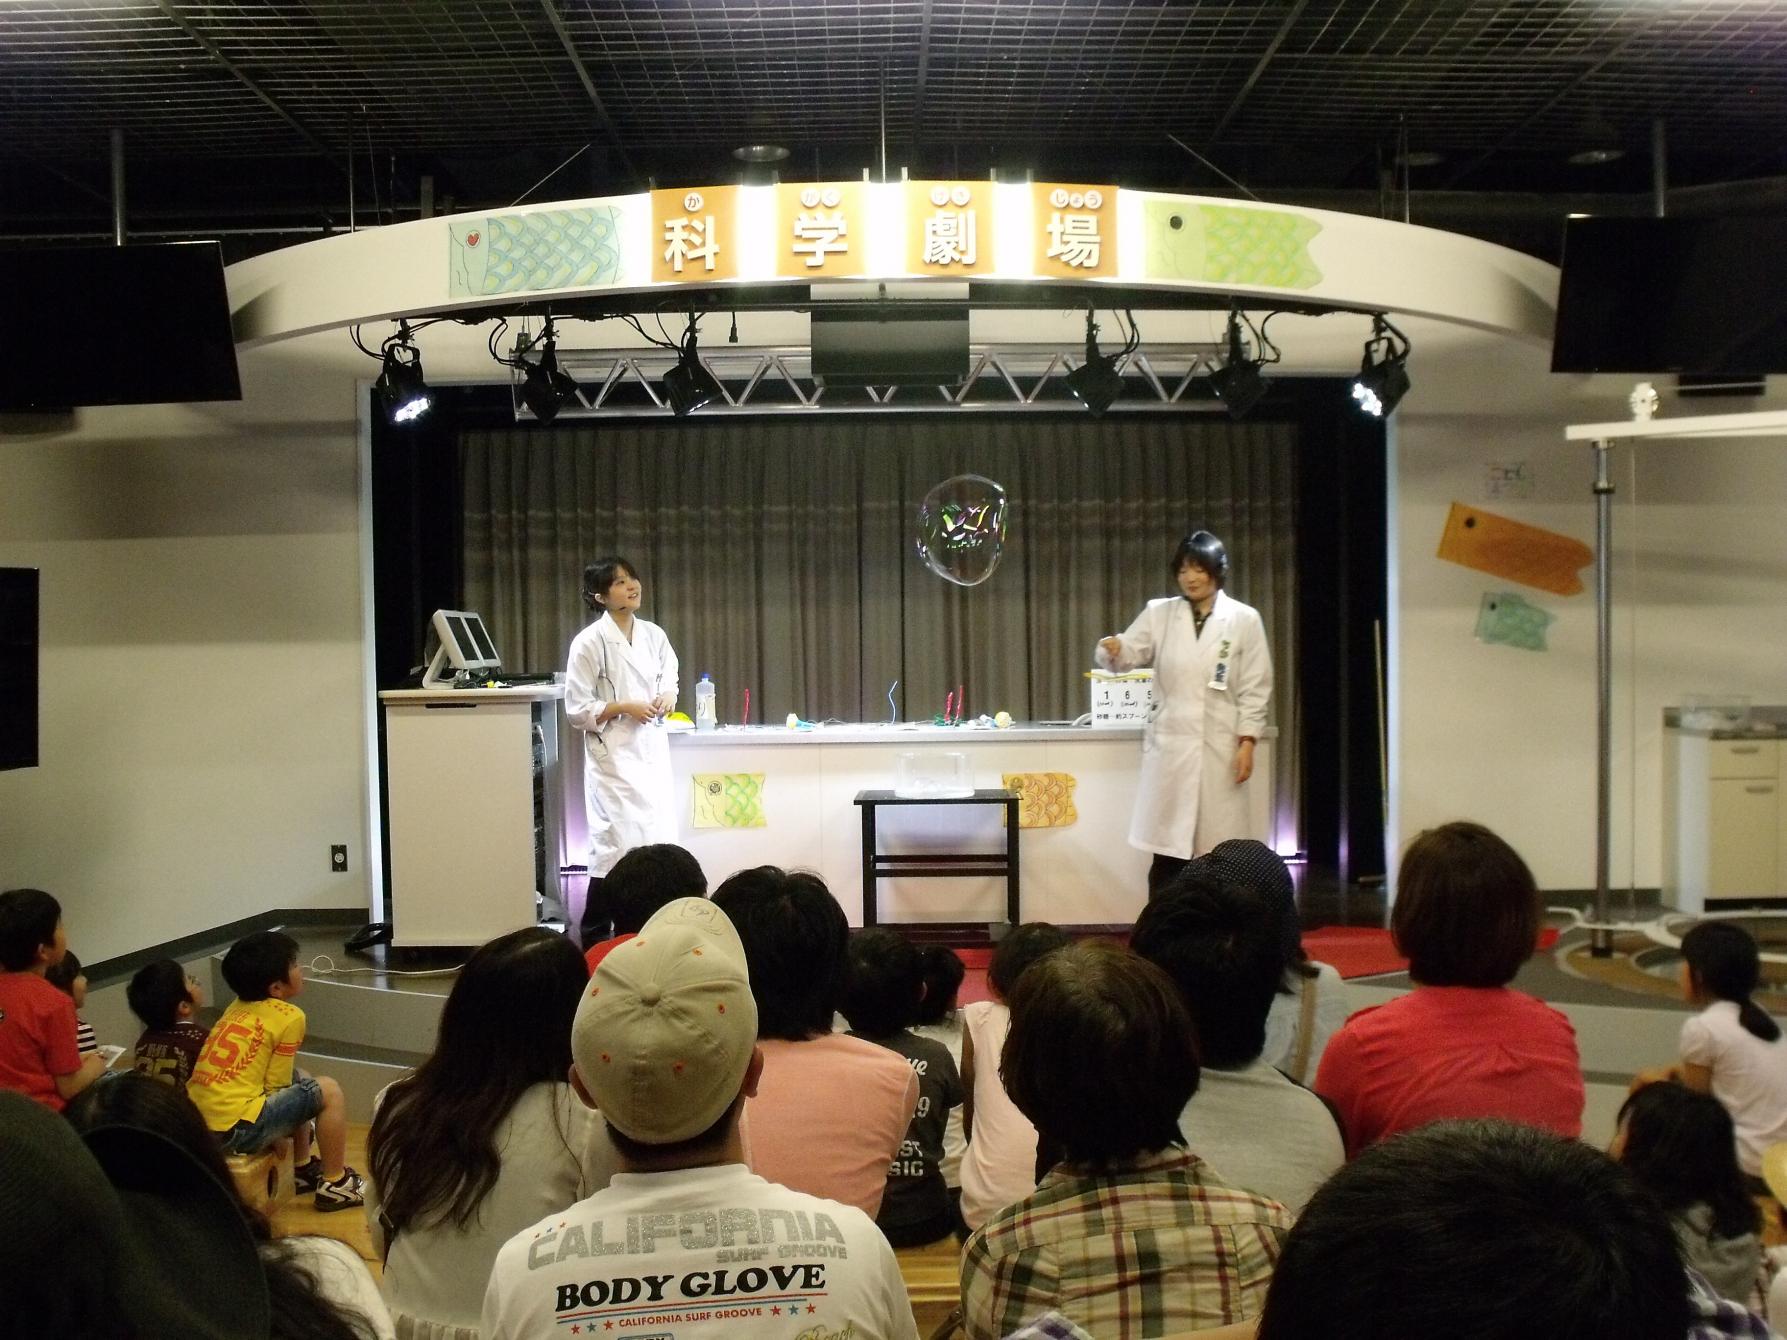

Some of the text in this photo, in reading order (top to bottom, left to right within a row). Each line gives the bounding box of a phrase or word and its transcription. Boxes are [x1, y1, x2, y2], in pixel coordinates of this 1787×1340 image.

[685, 195, 702, 210] か
[1055, 189, 1100, 207] じょう
[664, 210, 1101, 272] 科学劇場
[1104, 690, 1109, 700] 1
[1125, 690, 1130, 700] 6
[528, 1208, 846, 1270] CALIFORNIA
[716, 1244, 847, 1263] SURF GROOVE
[555, 1264, 826, 1312] BODY GLOVE
[619, 1307, 762, 1328] CALIFORNIA SURF GROOVE
